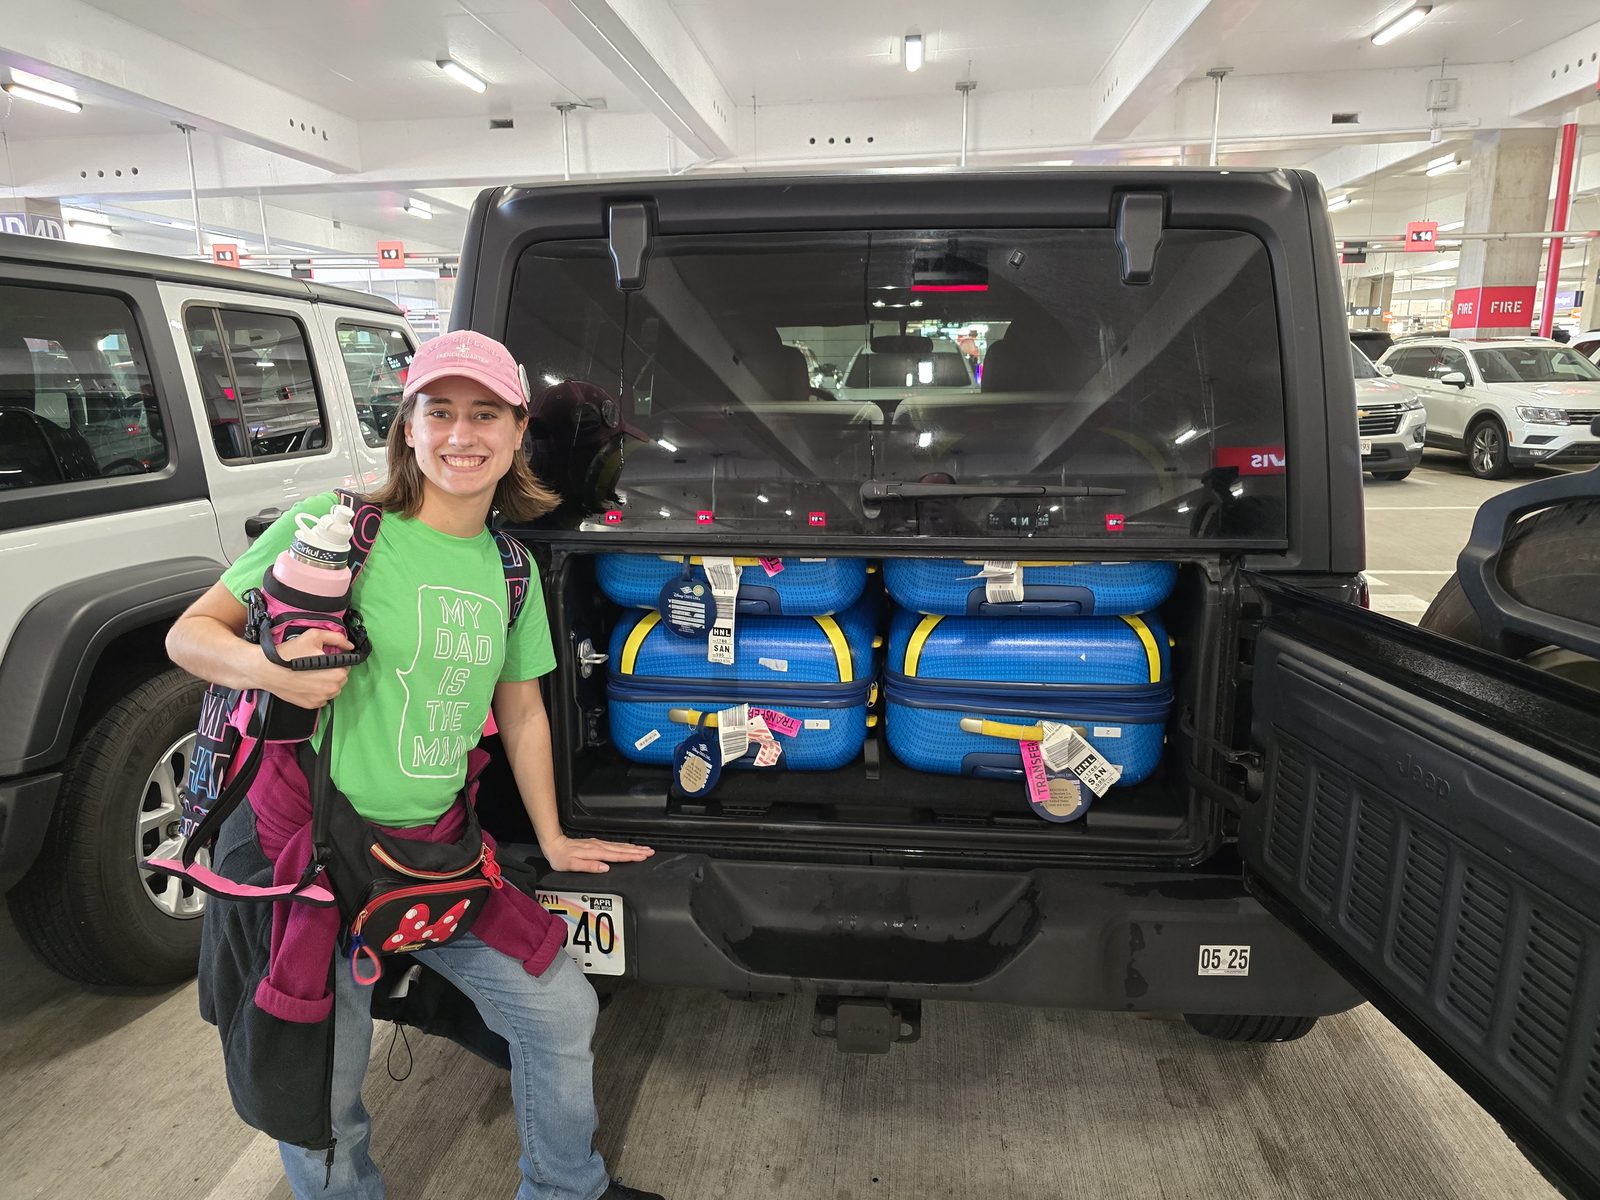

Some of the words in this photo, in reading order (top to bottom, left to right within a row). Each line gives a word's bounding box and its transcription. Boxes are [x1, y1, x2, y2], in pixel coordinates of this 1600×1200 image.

[1457, 302, 1473, 315] FIRE
[1490, 301, 1523, 314] FIRE
[296, 541, 320, 557] Cirkul
[438, 595, 482, 629] MY
[713, 628, 731, 637] HNL
[433, 627, 492, 665] DAD
[713, 644, 730, 653] SAN
[437, 666, 471, 696] IS
[426, 700, 471, 732] THE
[1075, 754, 1097, 775] HNL
[1087, 767, 1107, 785] SAN
[1396, 753, 1451, 797] Jeep
[593, 899, 611, 907] APR
[1201, 948, 1221, 969] 05
[1227, 948, 1248, 969] 25
